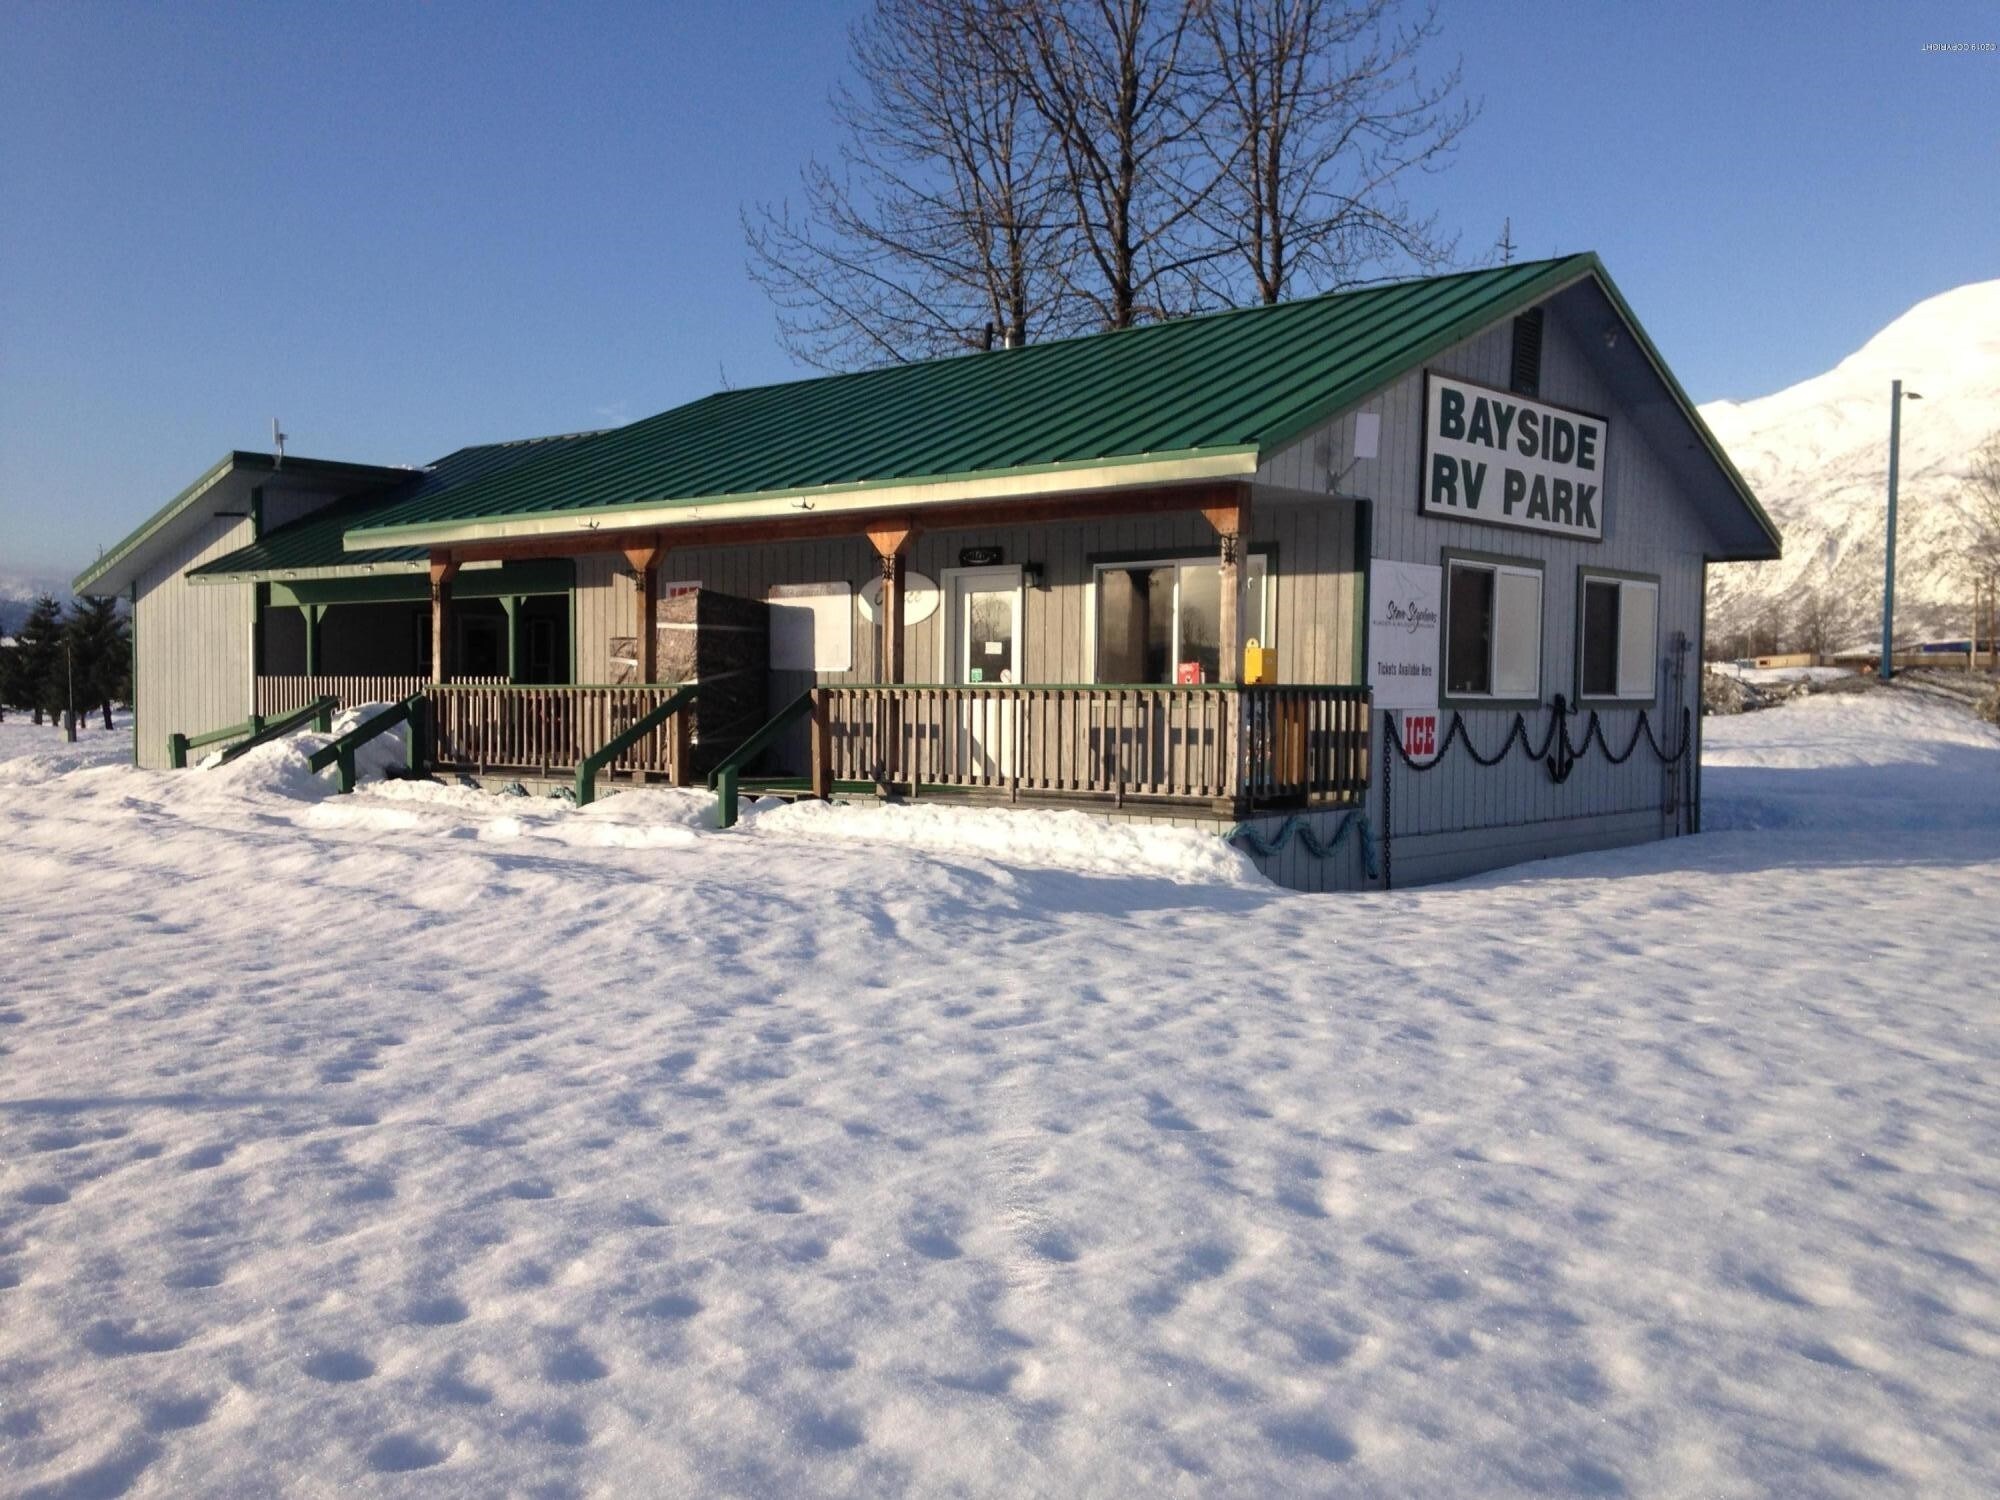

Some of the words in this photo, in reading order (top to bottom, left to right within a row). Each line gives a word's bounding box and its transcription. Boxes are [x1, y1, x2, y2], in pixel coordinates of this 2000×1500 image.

[1440, 387, 1598, 471] BAYSIDE
[1431, 453, 1487, 510] RV
[1503, 467, 1598, 529] PARK
[1377, 661, 1397, 676] Tickets
[1398, 661, 1420, 677] Available
[1405, 716, 1435, 755] ICE
